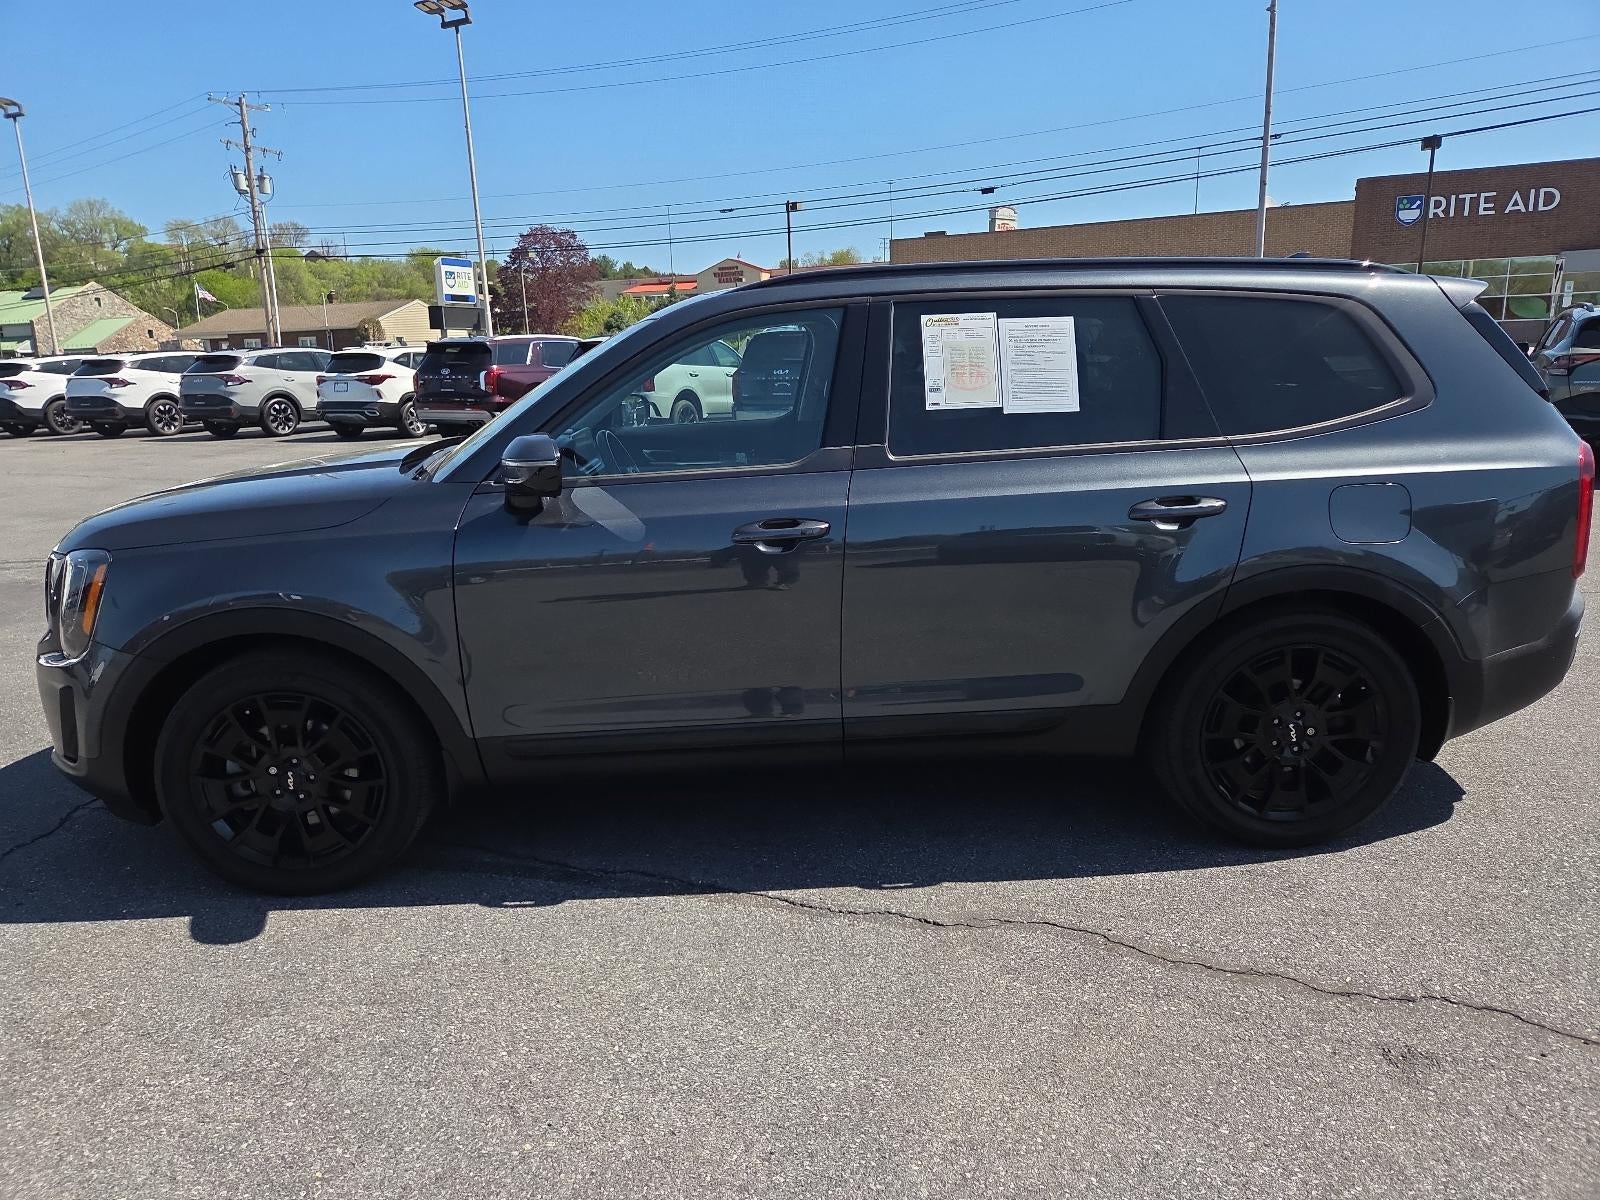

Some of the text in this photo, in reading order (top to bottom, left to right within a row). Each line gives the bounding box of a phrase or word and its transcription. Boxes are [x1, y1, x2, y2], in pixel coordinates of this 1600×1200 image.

[1428, 187, 1561, 219] RITE AID
[456, 271, 472, 281] RITE
[457, 281, 469, 289] AID
